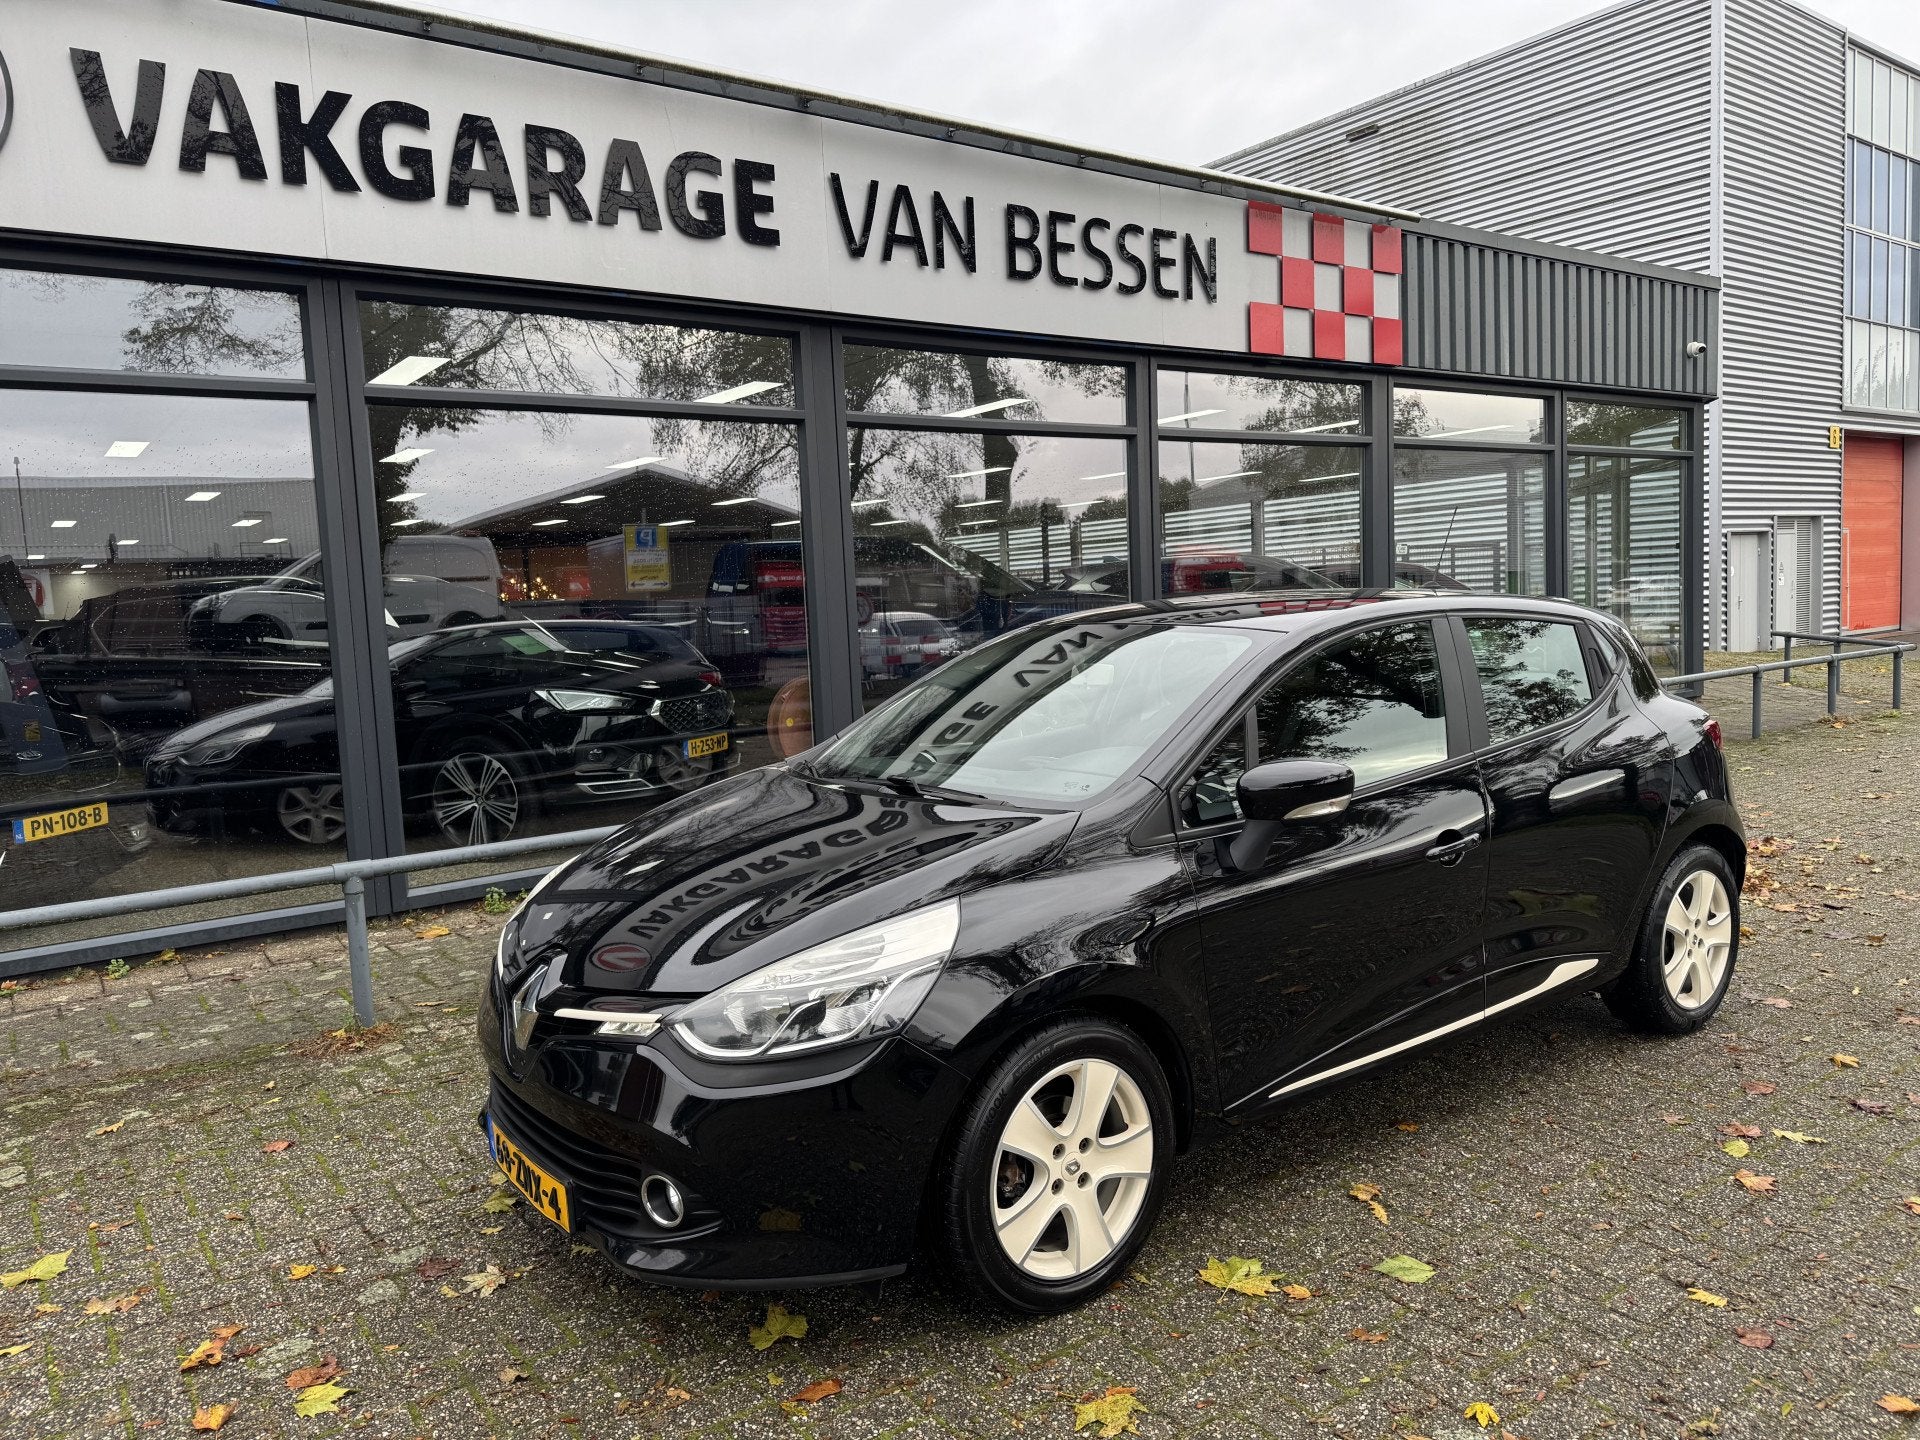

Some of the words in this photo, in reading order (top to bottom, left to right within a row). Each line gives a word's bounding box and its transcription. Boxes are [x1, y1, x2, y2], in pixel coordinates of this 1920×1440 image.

[69, 47, 781, 247] VAKGARAGE
[830, 172, 977, 273] VAN
[1006, 202, 1217, 303] BESSEN
[690, 734, 726, 755] H-253-NP
[30, 807, 102, 838] PN-108-B
